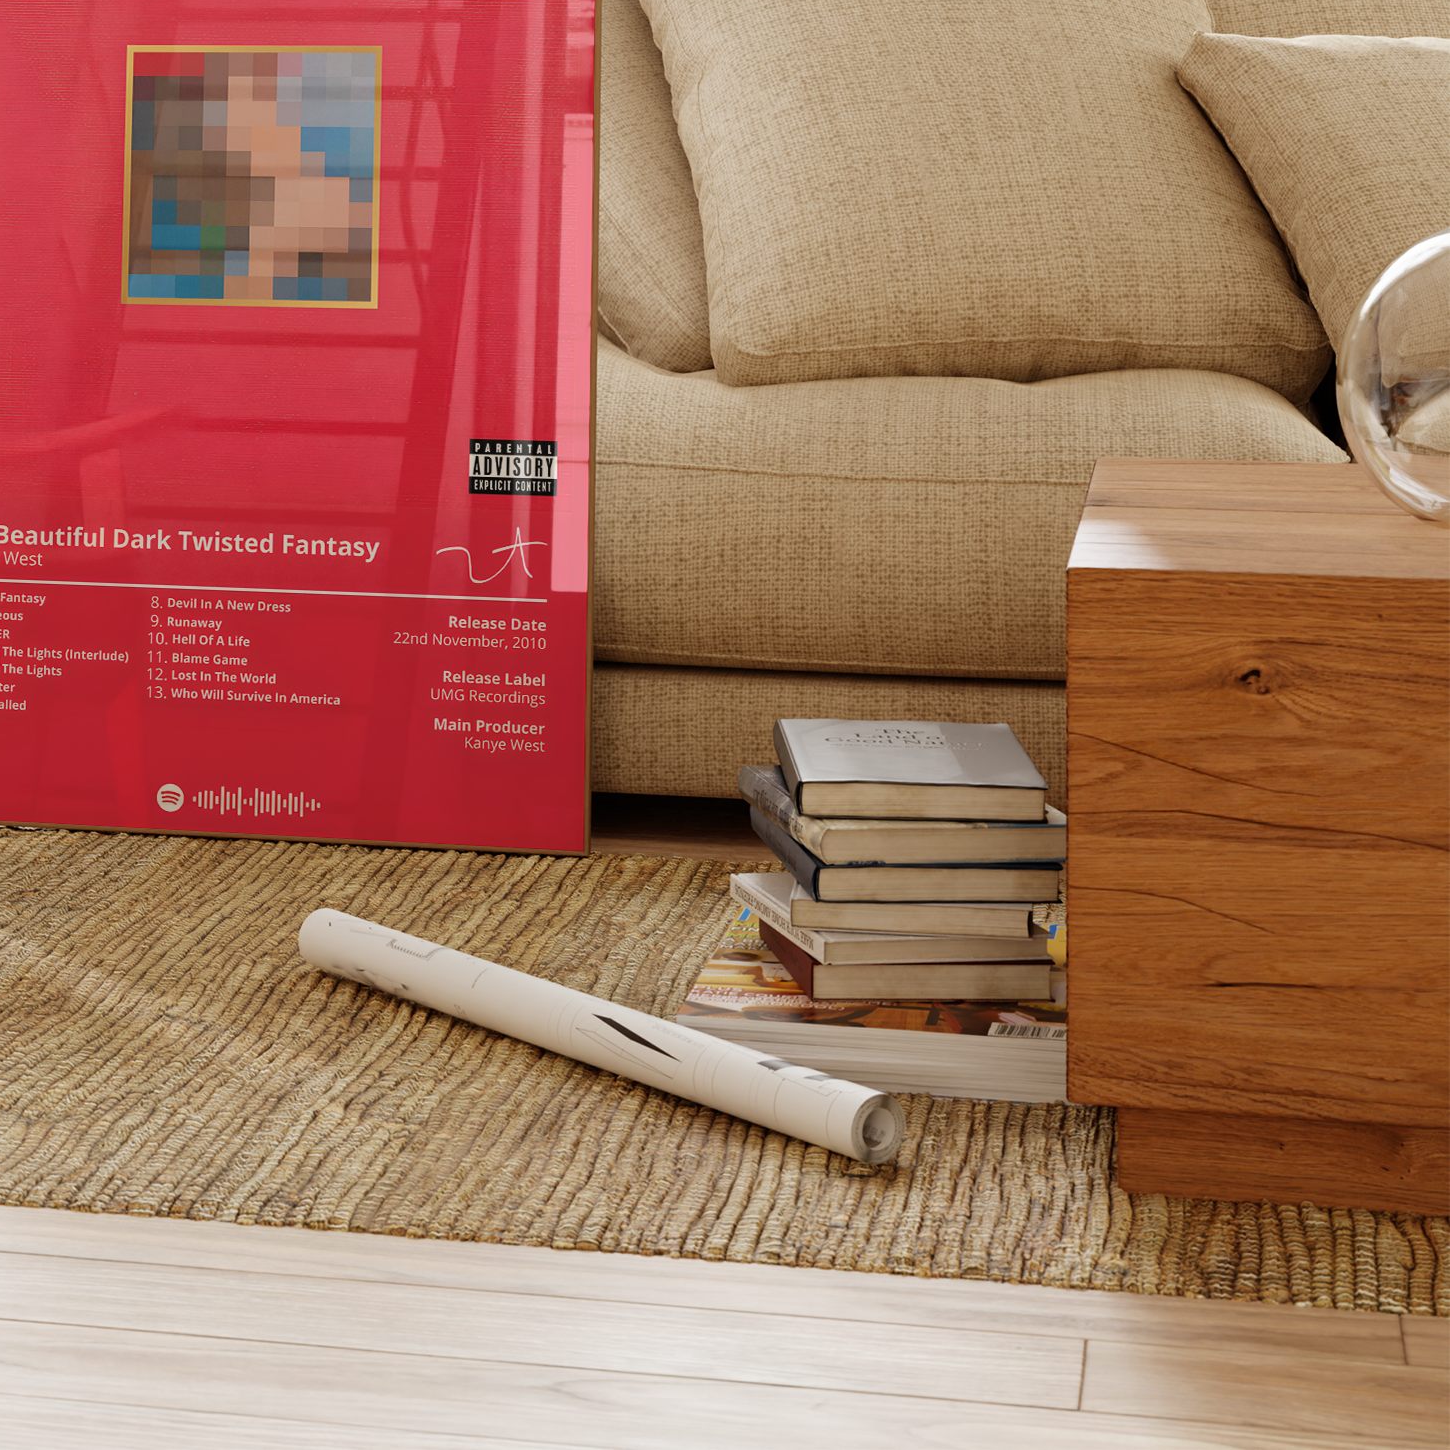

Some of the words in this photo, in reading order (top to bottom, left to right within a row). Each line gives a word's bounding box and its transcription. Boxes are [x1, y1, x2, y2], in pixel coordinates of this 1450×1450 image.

[474, 442, 553, 455] PARENTAL
[473, 455, 554, 478] ADVISORY
[474, 480, 512, 492] EXPLICIT
[515, 480, 552, 493] CONTENT
[112, 528, 172, 550] Dark
[177, 530, 274, 554] Twisted
[282, 533, 381, 562] Fantasy
[2, 550, 44, 567] West
[0, 591, 47, 607] Fantasy
[150, 595, 163, 609] 8.
[167, 597, 198, 609] Devil
[200, 598, 213, 610] In
[214, 599, 224, 610] A
[226, 599, 255, 612] New
[257, 600, 292, 613] Dress
[150, 614, 163, 628] 9.
[166, 616, 223, 632] Runaway
[448, 615, 507, 631] Release
[510, 617, 547, 632] Date
[147, 631, 169, 646] 10.
[172, 633, 196, 646] Hell
[198, 634, 214, 647] Of
[214, 635, 226, 647] A
[227, 635, 251, 648] Life
[393, 631, 428, 646] 22nd
[432, 633, 509, 651] November,
[512, 636, 547, 650] 2010
[2, 645, 24, 658] The
[26, 646, 63, 662] Lights
[64, 648, 130, 664] (Interlude)
[147, 650, 169, 665] 11.
[171, 652, 211, 666] Blame
[212, 654, 248, 667] Game
[1, 662, 24, 675] The
[26, 664, 63, 679] Lights
[146, 667, 168, 682] 12.
[171, 669, 198, 682] Lost
[199, 670, 212, 682] In
[214, 670, 238, 683] The
[239, 672, 277, 685] World
[442, 669, 501, 685] Release
[504, 672, 546, 687] Label
[146, 685, 167, 700] 13.
[170, 687, 199, 700] Who
[200, 688, 224, 701] Will
[226, 689, 273, 703] Survive
[275, 692, 287, 704] In
[289, 692, 341, 706] America
[430, 687, 465, 702] UMG
[469, 689, 546, 709] Recordings
[433, 717, 472, 733] Main
[475, 719, 546, 736] Producer
[464, 736, 507, 754] Kanye
[510, 738, 546, 753] West
